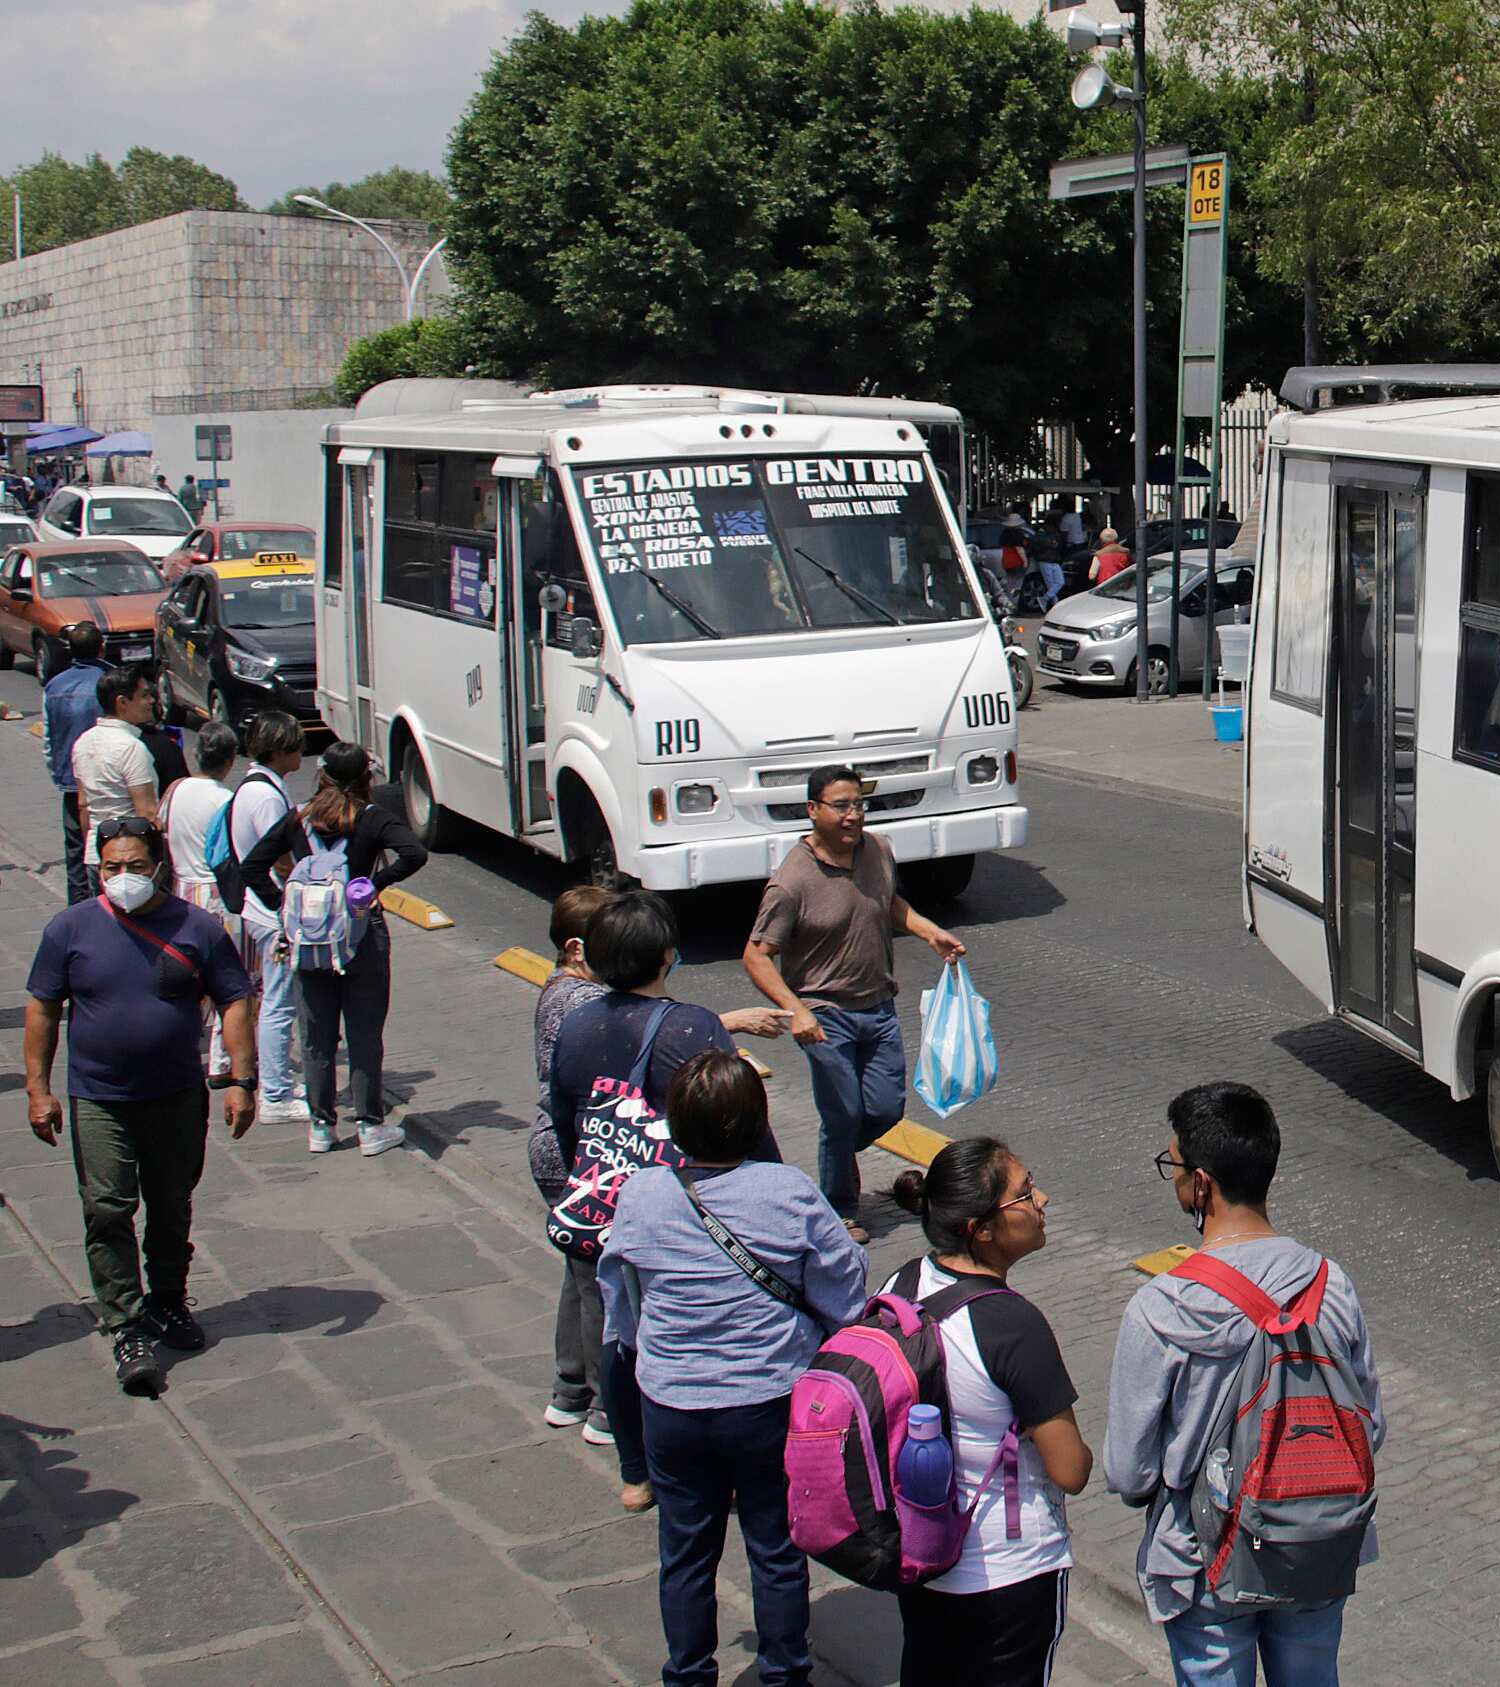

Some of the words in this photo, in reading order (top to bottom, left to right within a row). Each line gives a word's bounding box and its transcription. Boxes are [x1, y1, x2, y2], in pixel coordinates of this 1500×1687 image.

[1197, 168, 1220, 191] 18
[1194, 197, 1220, 214] OTE
[583, 464, 752, 499] ESTADIOS
[767, 459, 924, 485] CENTRO
[591, 496, 634, 513] CENTRAL
[634, 495, 649, 509] DE
[651, 491, 695, 507] ABASTOS
[827, 484, 857, 498] VILLA
[593, 506, 701, 528] XONACA
[808, 502, 854, 519] HOSPITAL
[853, 501, 872, 516] DEL
[870, 500, 901, 515] NORTE
[601, 527, 625, 542] LA
[629, 520, 703, 539] CIENEGA
[645, 536, 715, 553] ROSA
[262, 554, 295, 563] TAXI
[647, 550, 712, 570] LORETO
[963, 691, 1010, 728] U06
[655, 718, 701, 756] R19
[615, 1127, 654, 1162] SAN
